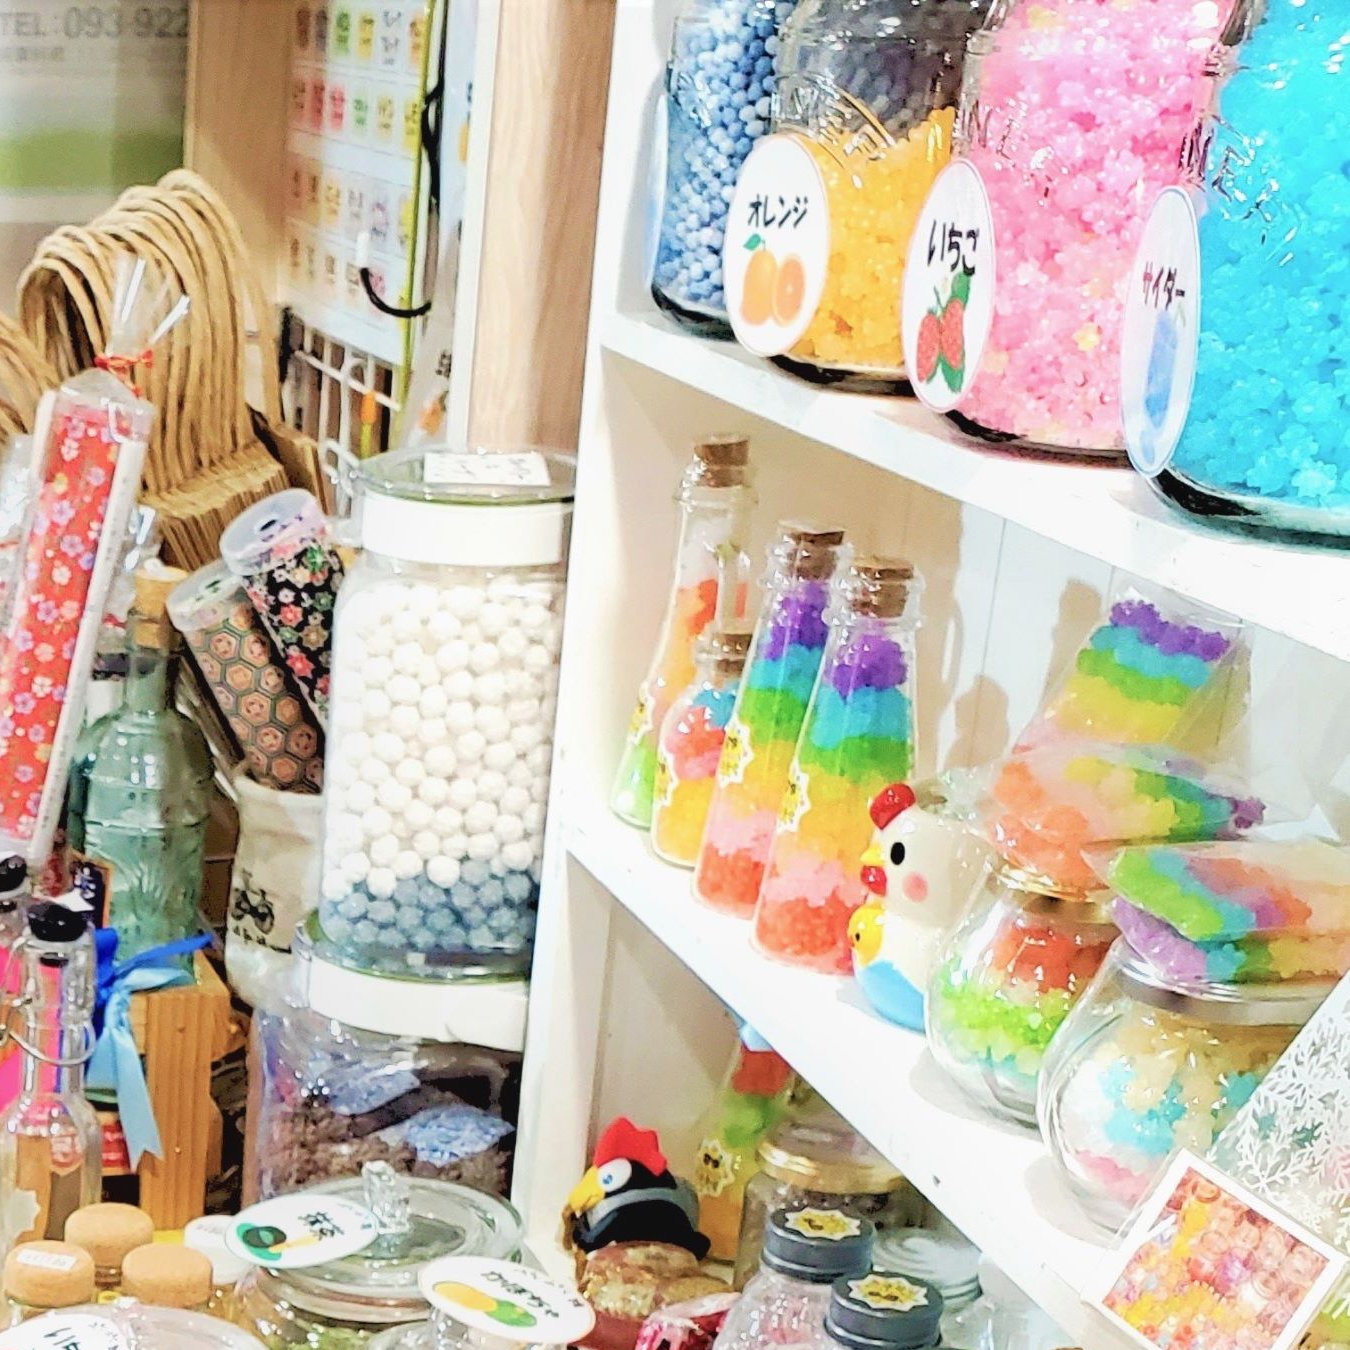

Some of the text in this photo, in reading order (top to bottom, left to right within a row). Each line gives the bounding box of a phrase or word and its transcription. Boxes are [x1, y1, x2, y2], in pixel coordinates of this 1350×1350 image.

[747, 194, 809, 229] オレンジ
[927, 219, 980, 277] いちご
[1142, 261, 1186, 311] サイダー
